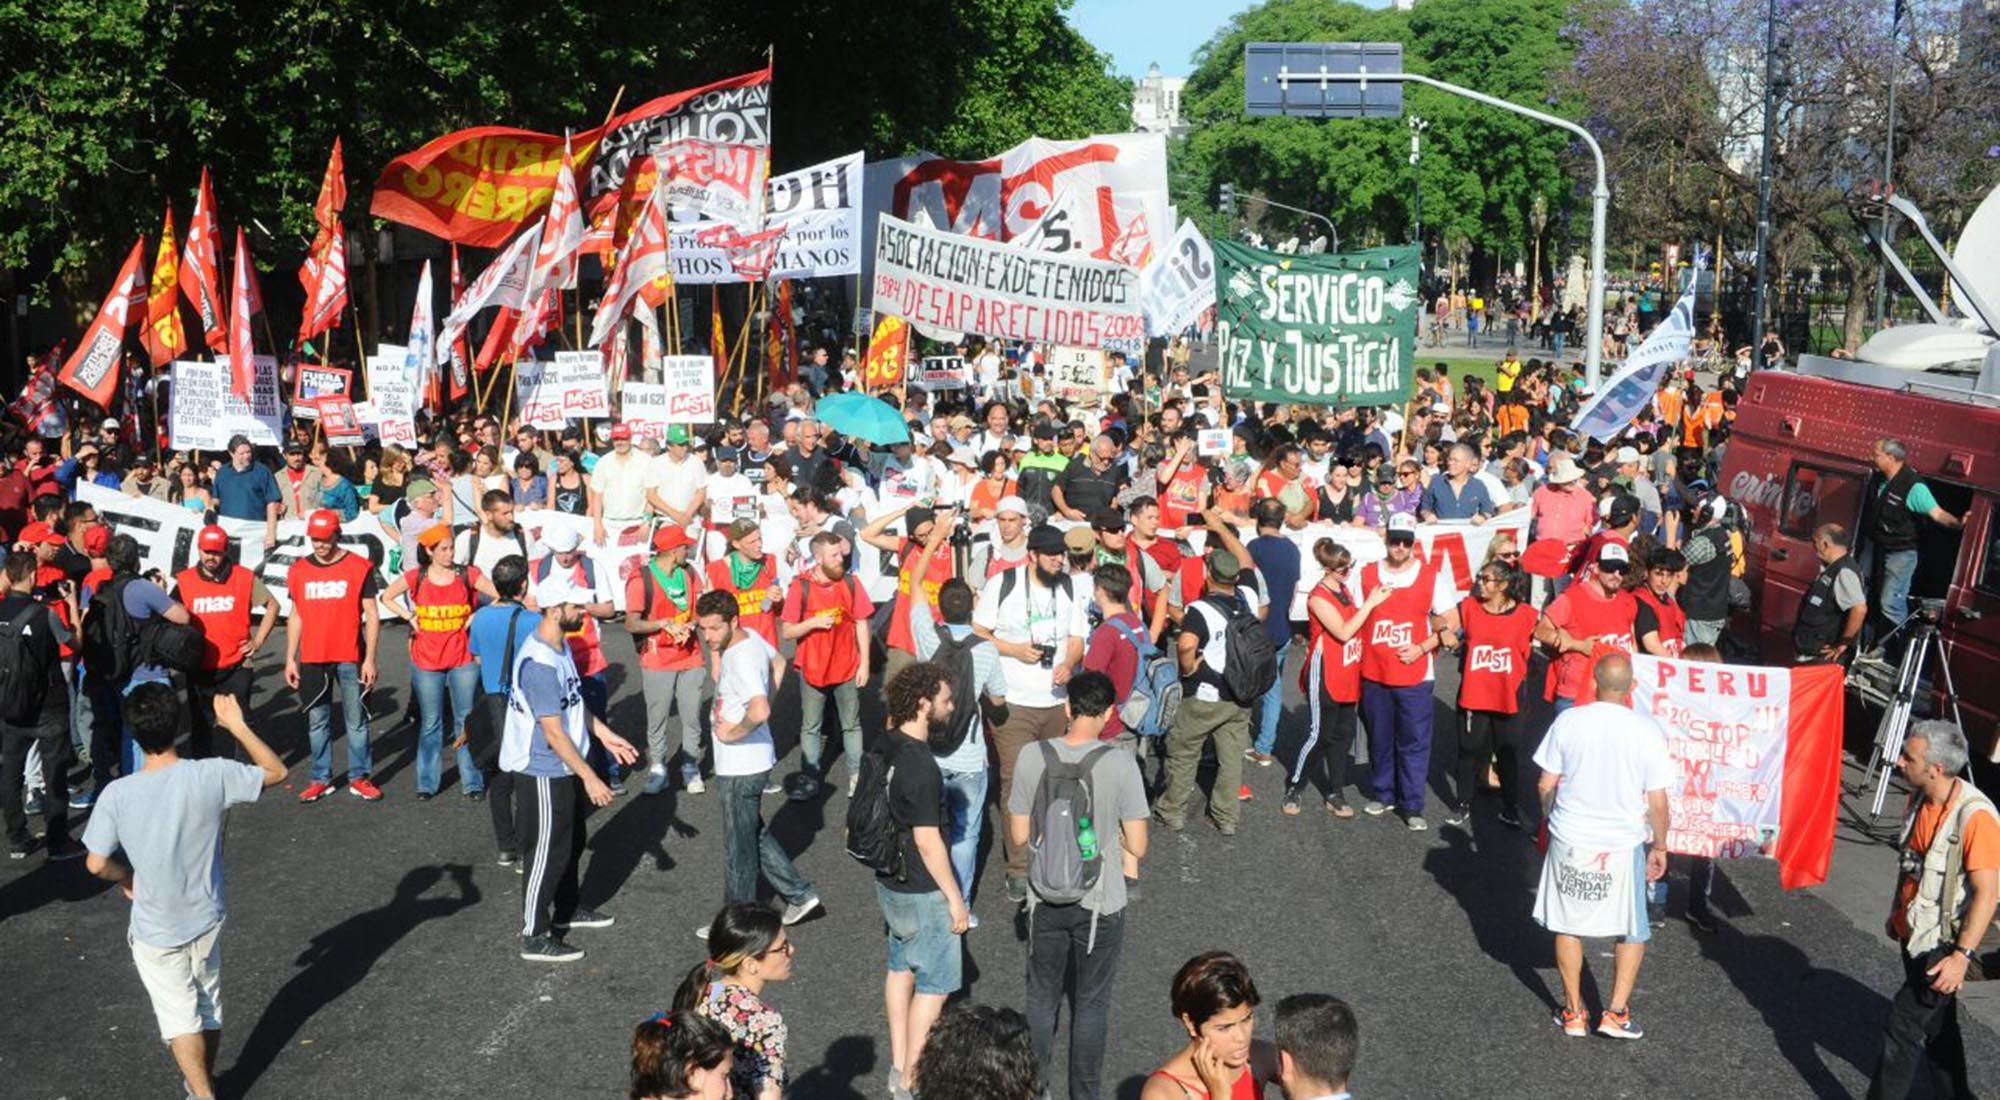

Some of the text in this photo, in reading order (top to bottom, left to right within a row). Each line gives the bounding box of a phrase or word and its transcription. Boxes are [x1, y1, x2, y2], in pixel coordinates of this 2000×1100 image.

[797, 224, 849, 246] por los
[902, 279, 1099, 348] DESAPARECIDOS
[1260, 339, 1278, 390] Y
[564, 389, 604, 410] MST
[671, 393, 711, 416] MST
[381, 419, 413, 441] MST
[304, 580, 348, 599] mas
[193, 595, 235, 613] mas
[415, 603, 472, 618] PARTIDO
[1375, 624, 1413, 644] MST
[1475, 649, 1511, 669] MST
[1657, 661, 1767, 697] PERU
[1688, 711, 1751, 746] STOP
